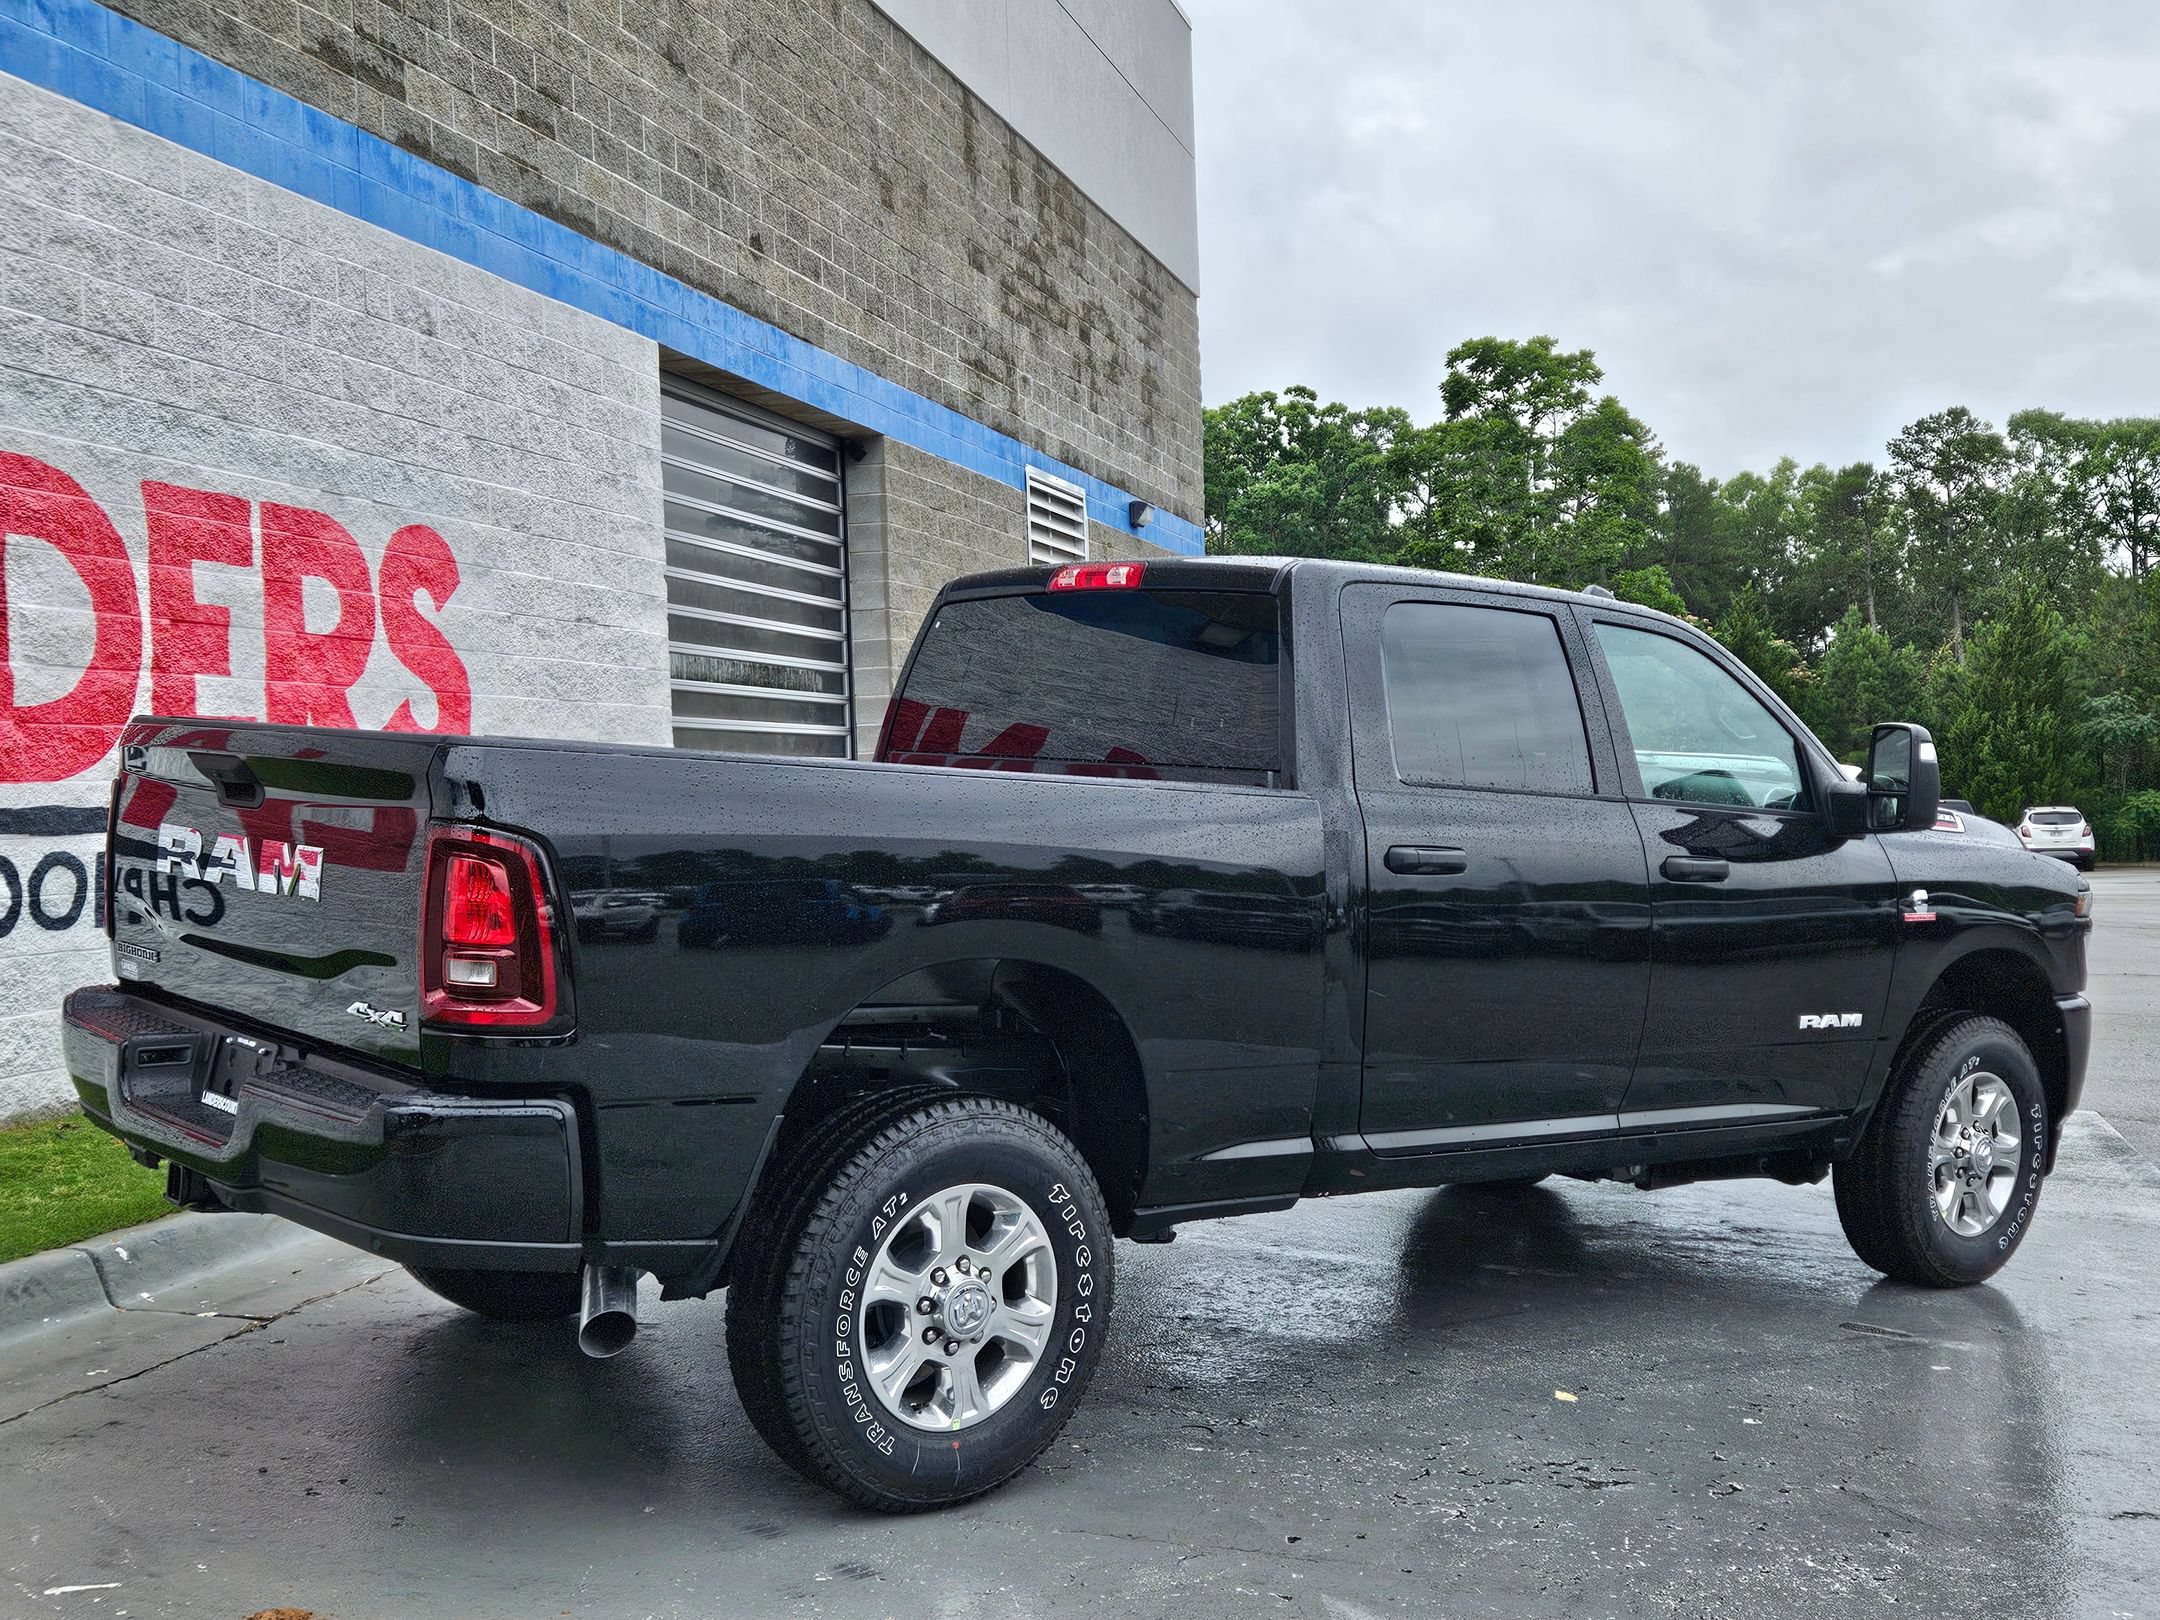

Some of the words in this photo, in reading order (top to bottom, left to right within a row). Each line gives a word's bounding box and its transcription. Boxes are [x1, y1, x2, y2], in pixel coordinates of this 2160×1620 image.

[157, 823, 325, 902] RAM
[1800, 1013, 1863, 1029] RAM
[836, 1245, 896, 1456] TRANSFORCE
